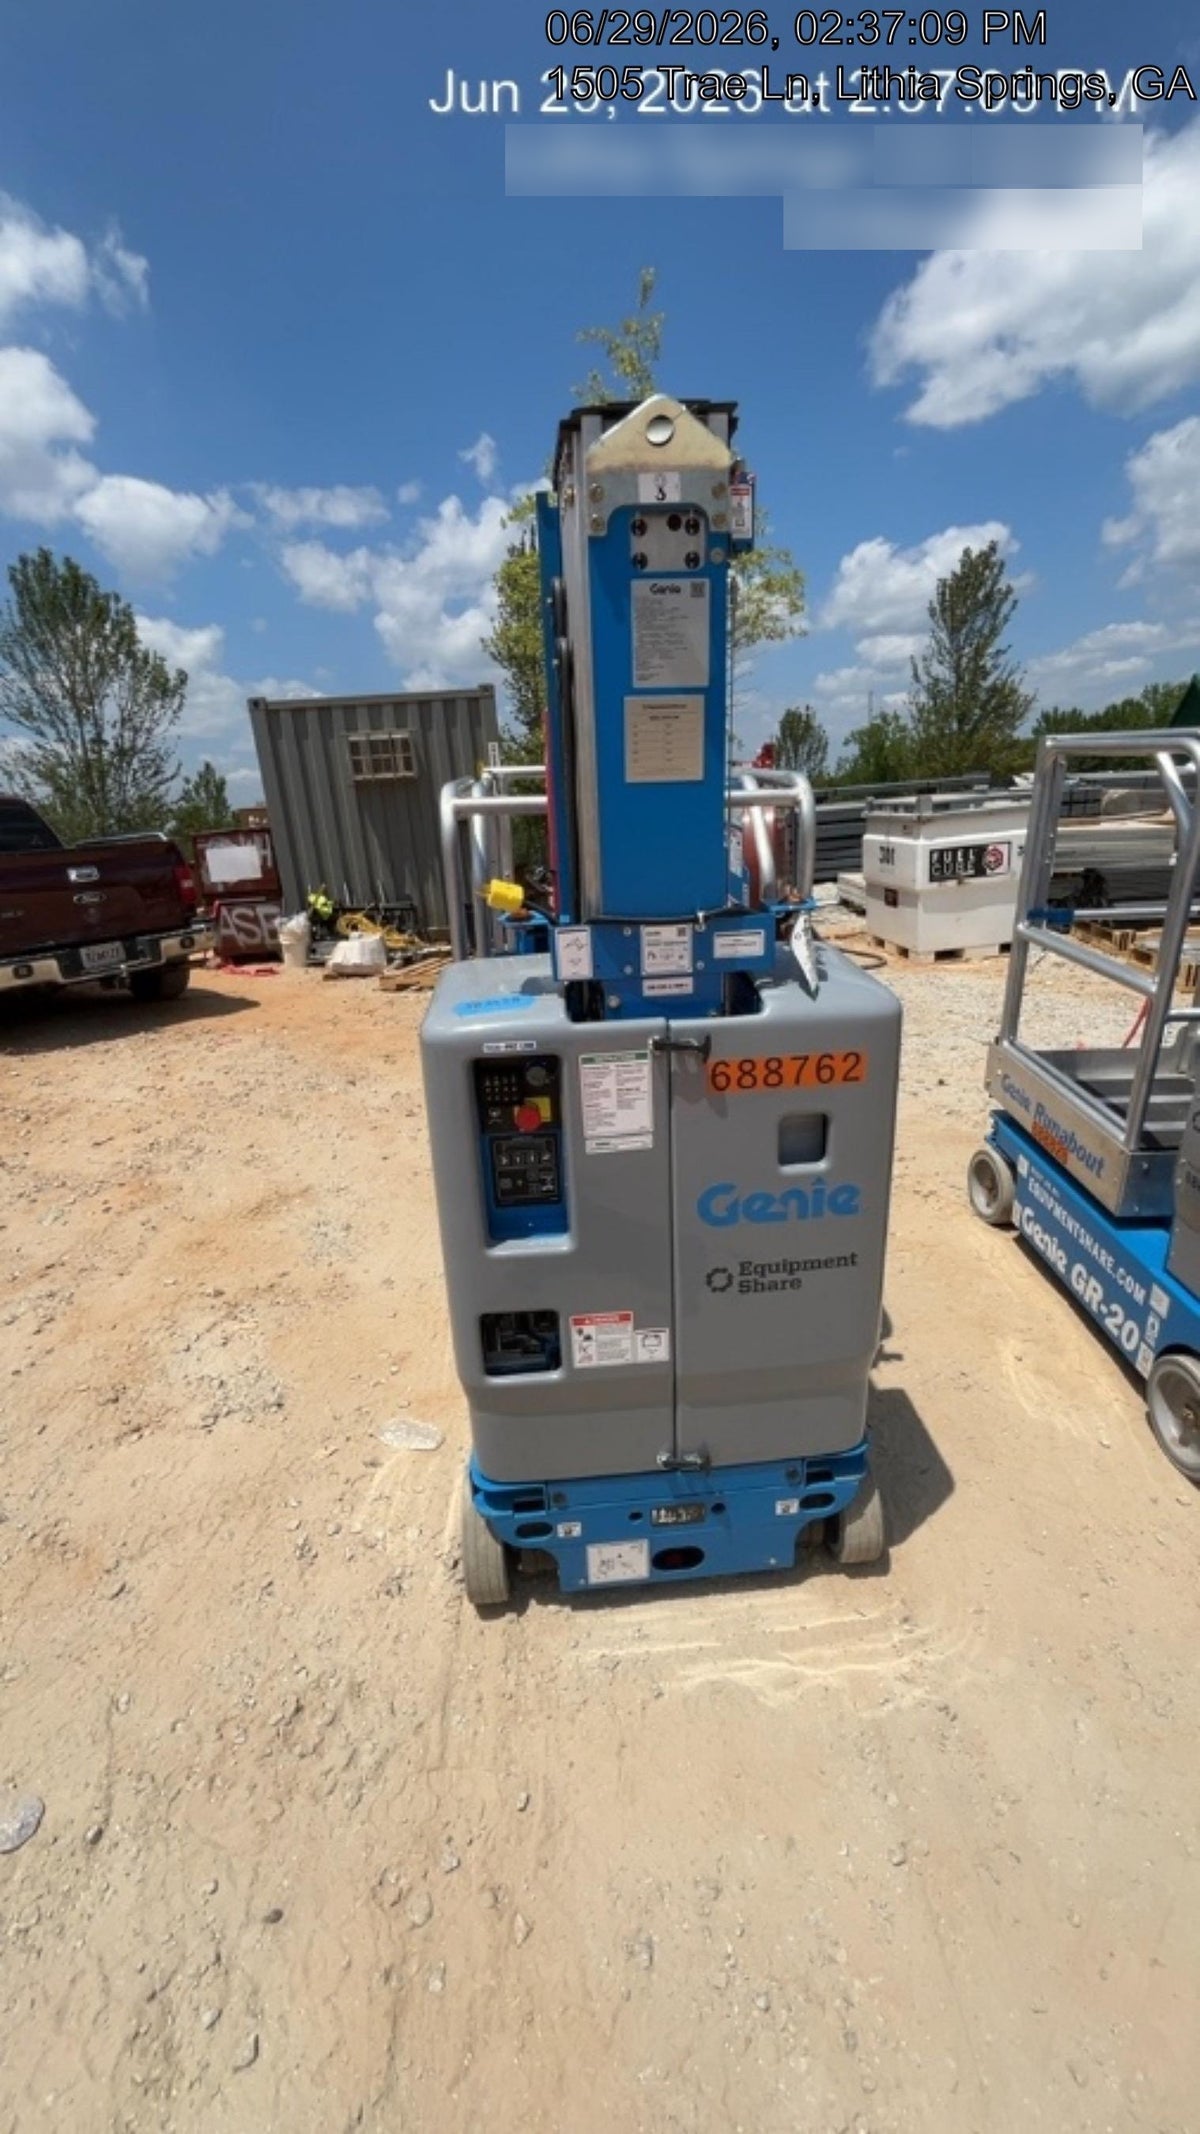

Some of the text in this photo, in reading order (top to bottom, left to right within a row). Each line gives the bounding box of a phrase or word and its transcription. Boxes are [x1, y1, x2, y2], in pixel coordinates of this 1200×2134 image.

[711, 1052, 861, 1092] 688762
[1034, 1102, 1105, 1177] Runabout
[696, 1177, 860, 1227] Genie
[738, 1252, 859, 1278] Equipment
[1028, 1178, 1147, 1307] EQUIPMENTSHARE.COM
[738, 1277, 803, 1293] Share
[1022, 1206, 1068, 1274] Genie
[1071, 1262, 1140, 1352] GR-20
